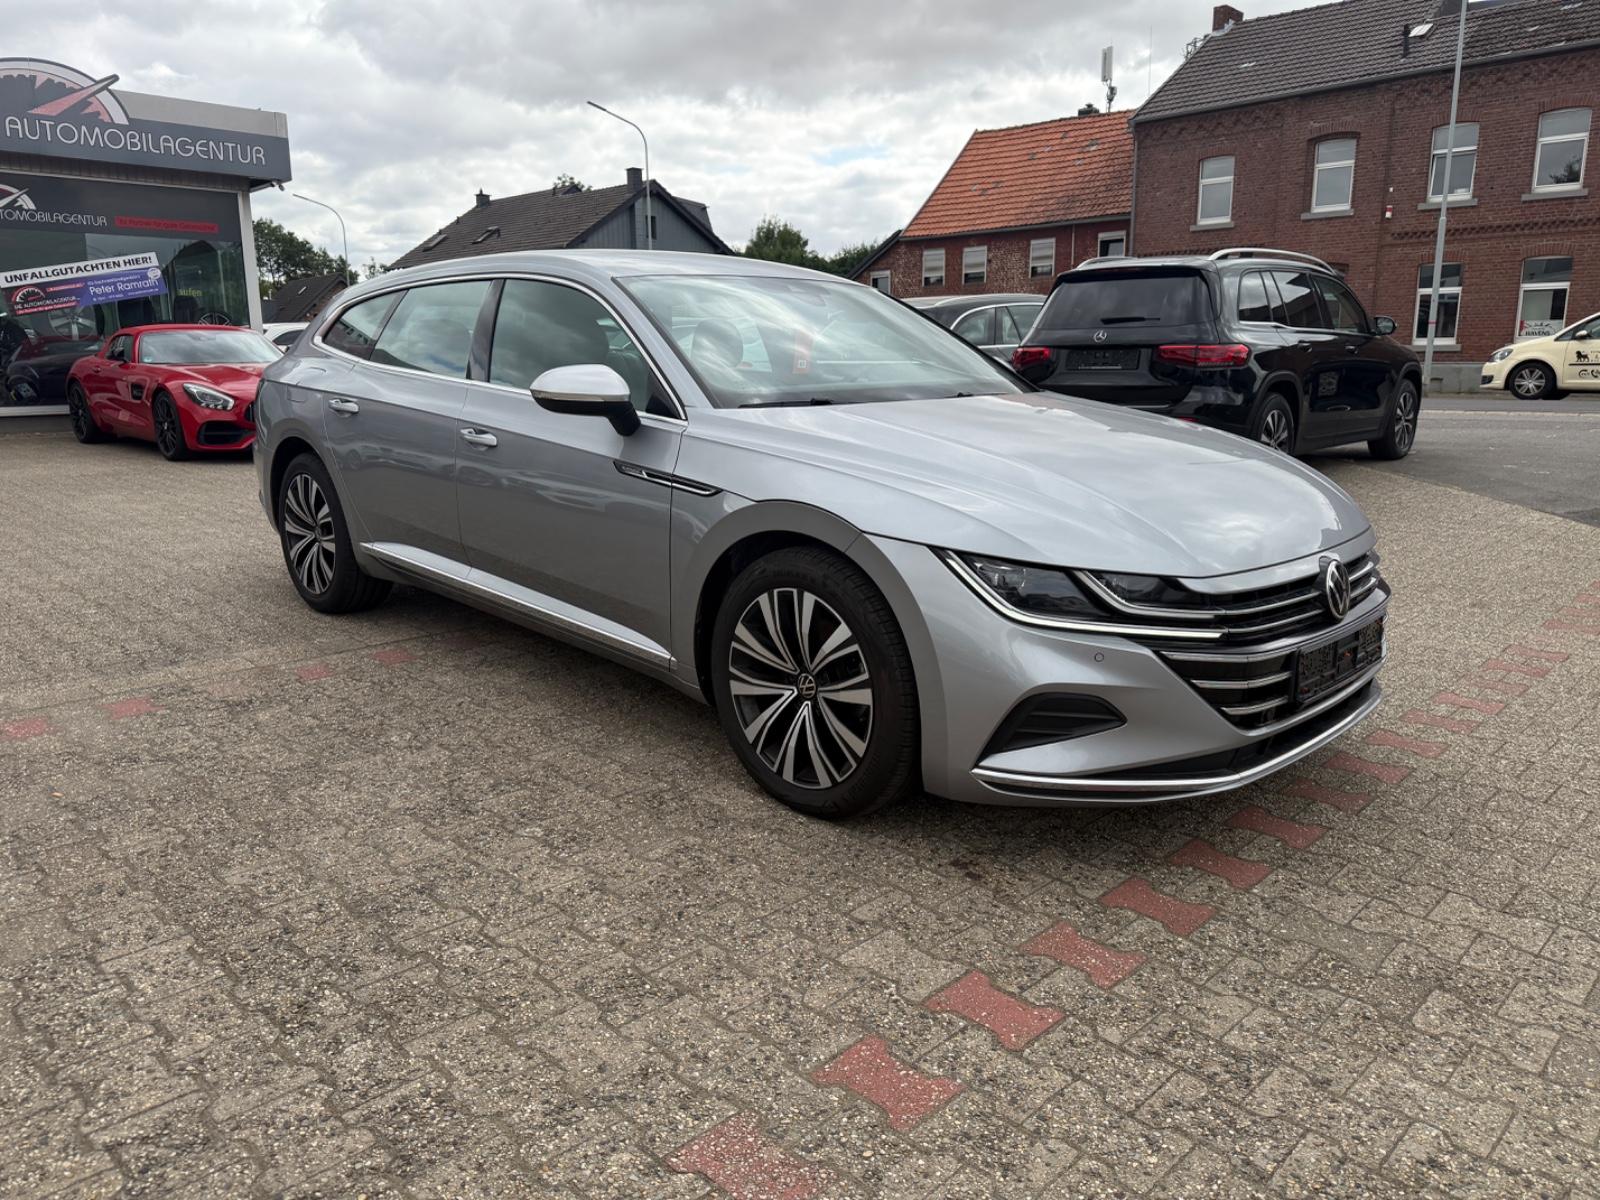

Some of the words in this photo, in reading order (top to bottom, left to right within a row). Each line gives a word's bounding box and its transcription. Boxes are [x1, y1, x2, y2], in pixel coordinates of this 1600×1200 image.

[5, 116, 266, 166] AUTOMOBILAGENTUR
[4, 261, 121, 283] UNFALLGUTACHTEN
[123, 255, 152, 270] HIER!
[89, 285, 115, 296] Peter
[116, 278, 158, 291] Ramrath
